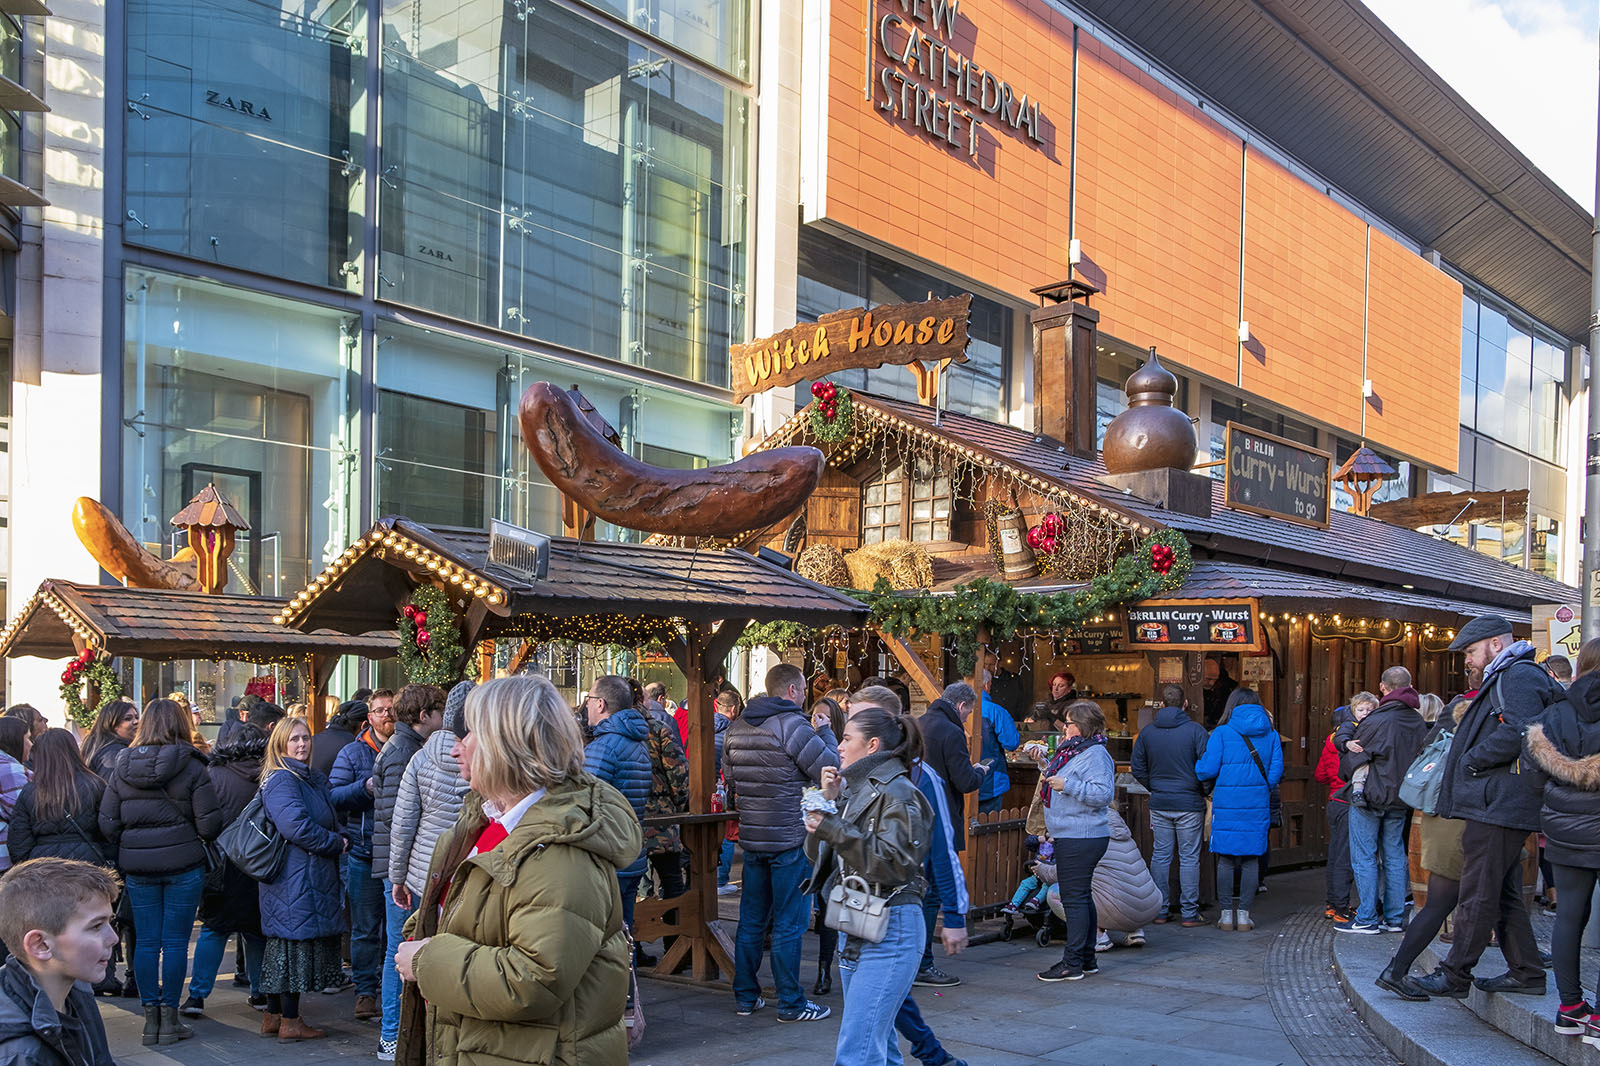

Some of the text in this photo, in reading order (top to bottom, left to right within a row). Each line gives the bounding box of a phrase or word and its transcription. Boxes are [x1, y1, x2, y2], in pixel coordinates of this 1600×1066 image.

[901, 0, 959, 39] EW
[881, 13, 1045, 144] CATHEDRAL
[206, 90, 272, 121] ZARA
[881, 67, 983, 156] STREET
[419, 245, 453, 262] ZARA
[745, 312, 954, 386] Witch House
[1295, 497, 1317, 520] to go
[1171, 611, 1203, 623] Curry
[1211, 610, 1249, 621] Wurst
[1188, 624, 1200, 632] go
[1083, 631, 1104, 639] Curry
